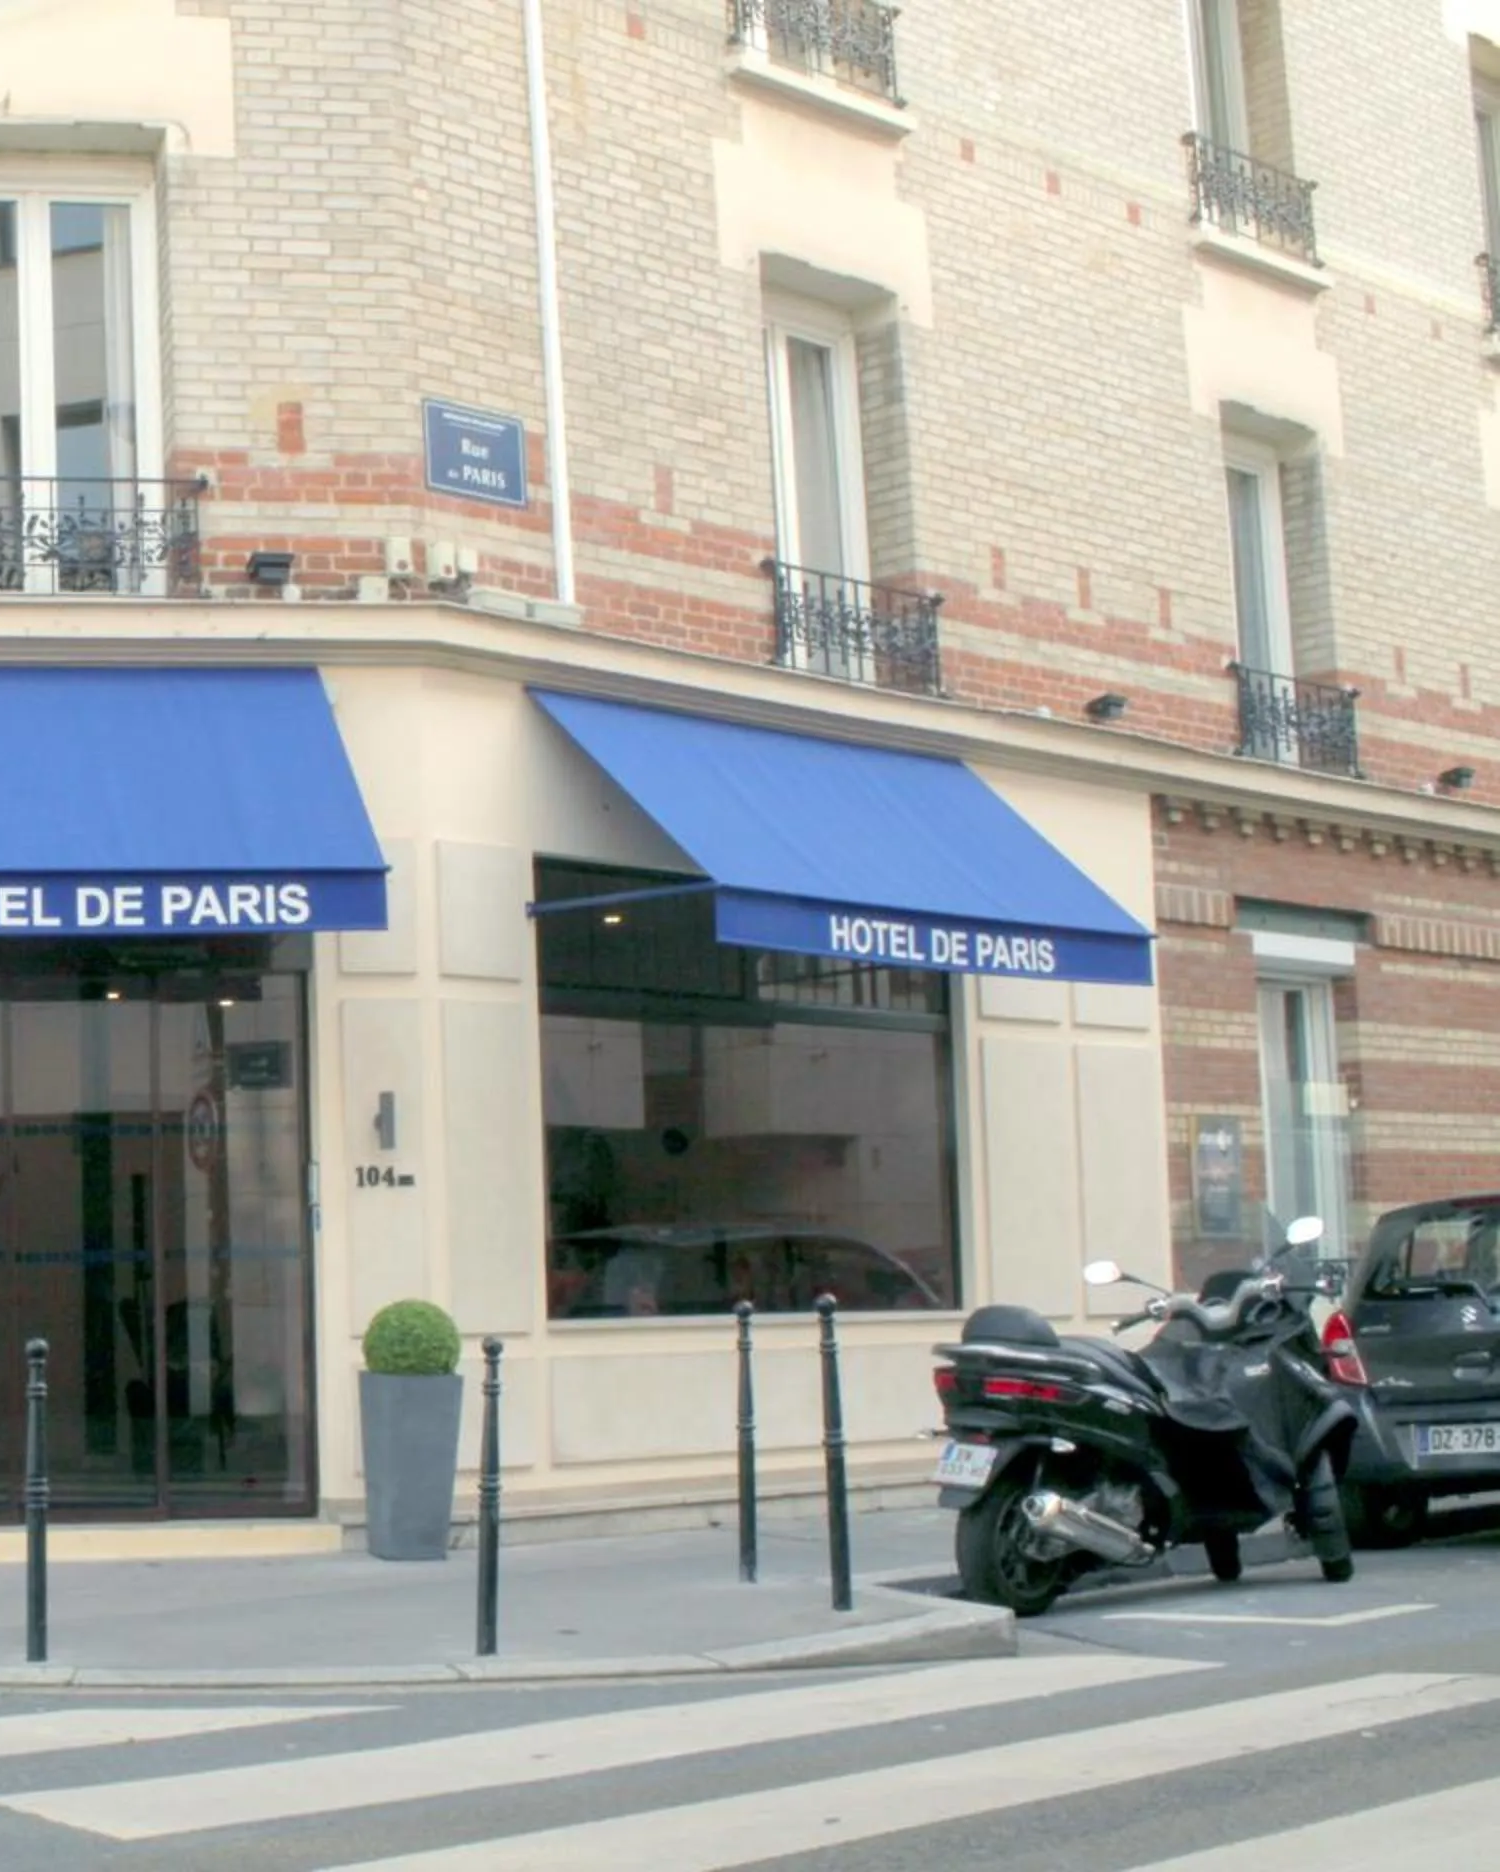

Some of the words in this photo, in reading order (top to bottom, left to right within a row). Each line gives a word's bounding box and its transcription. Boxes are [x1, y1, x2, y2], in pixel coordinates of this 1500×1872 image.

[461, 437, 489, 460] Rue
[462, 465, 506, 490] PARIS
[75, 886, 145, 927] DE
[160, 884, 311, 925] PARIS
[829, 914, 926, 962] HOTEL
[930, 927, 970, 968] DE
[975, 933, 1056, 974] PARIS
[355, 1165, 396, 1189] 104
